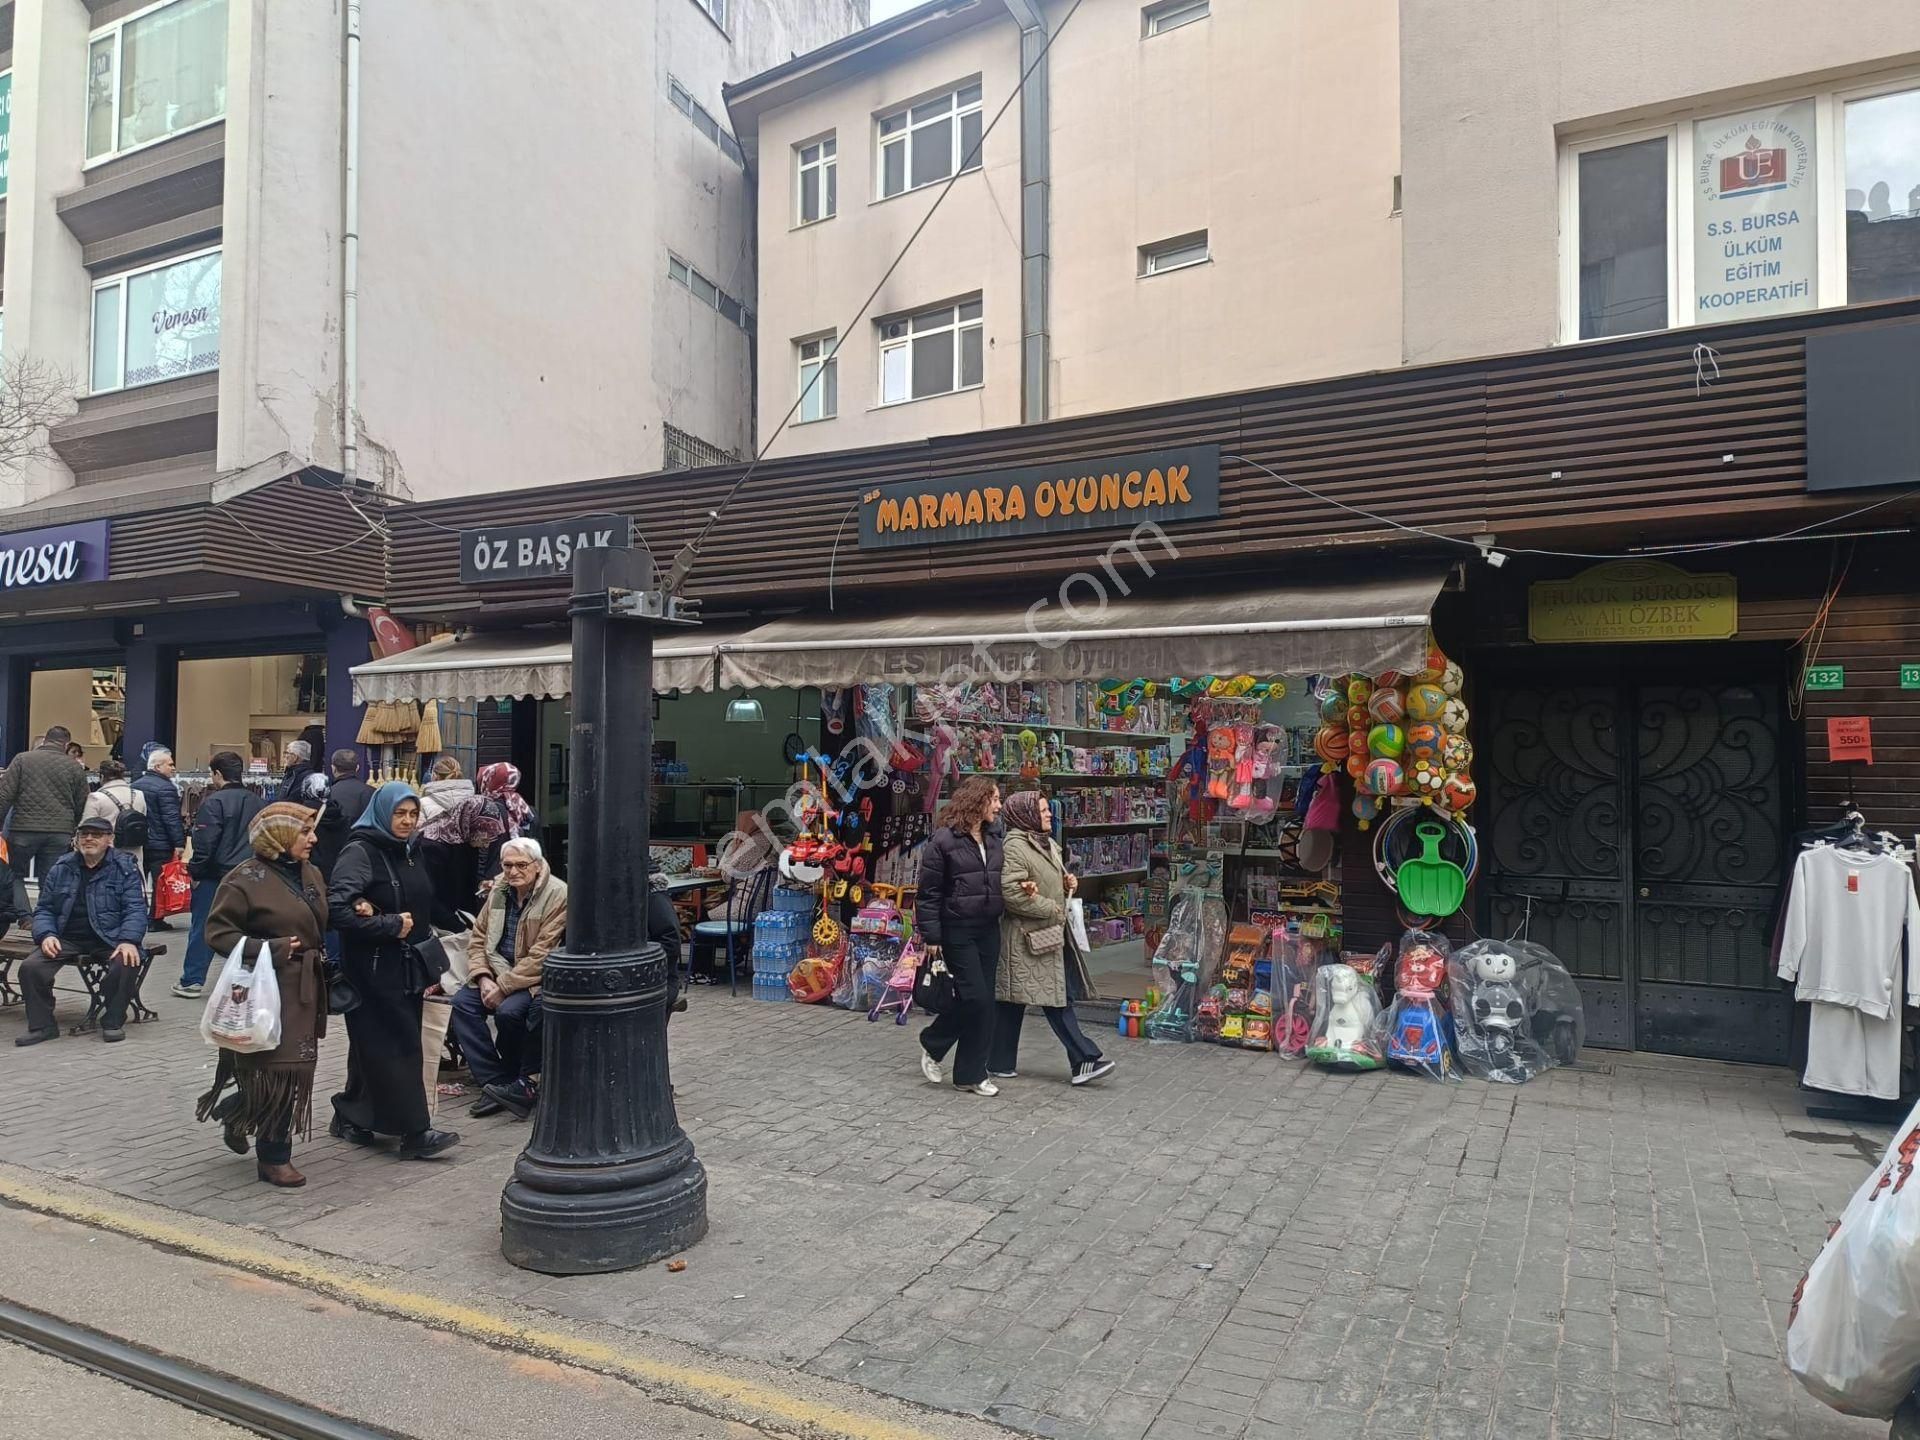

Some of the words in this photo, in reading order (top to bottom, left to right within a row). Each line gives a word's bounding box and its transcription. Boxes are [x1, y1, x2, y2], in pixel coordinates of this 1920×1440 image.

[1700, 153, 1715, 184] BURSA
[1707, 221, 1737, 237] S.S.
[1742, 209, 1800, 232] BURSA
[1724, 236, 1783, 259] ÜLKÜM
[1725, 259, 1781, 283] EĞİTİM
[1699, 278, 1809, 310] KOOPERATİFİ
[152, 306, 208, 334] Venesa
[876, 485, 1026, 534] MARMARA
[1035, 464, 1192, 518] OYUNCAK
[0, 540, 79, 587] nesa
[474, 535, 508, 571] ÖZ
[1543, 586, 1618, 606] HUKUK
[1632, 581, 1721, 601] BÜROSU
[1596, 607, 1622, 625] Ali
[1629, 604, 1701, 624] ÖZBEK
[1809, 672, 1840, 683] 132
